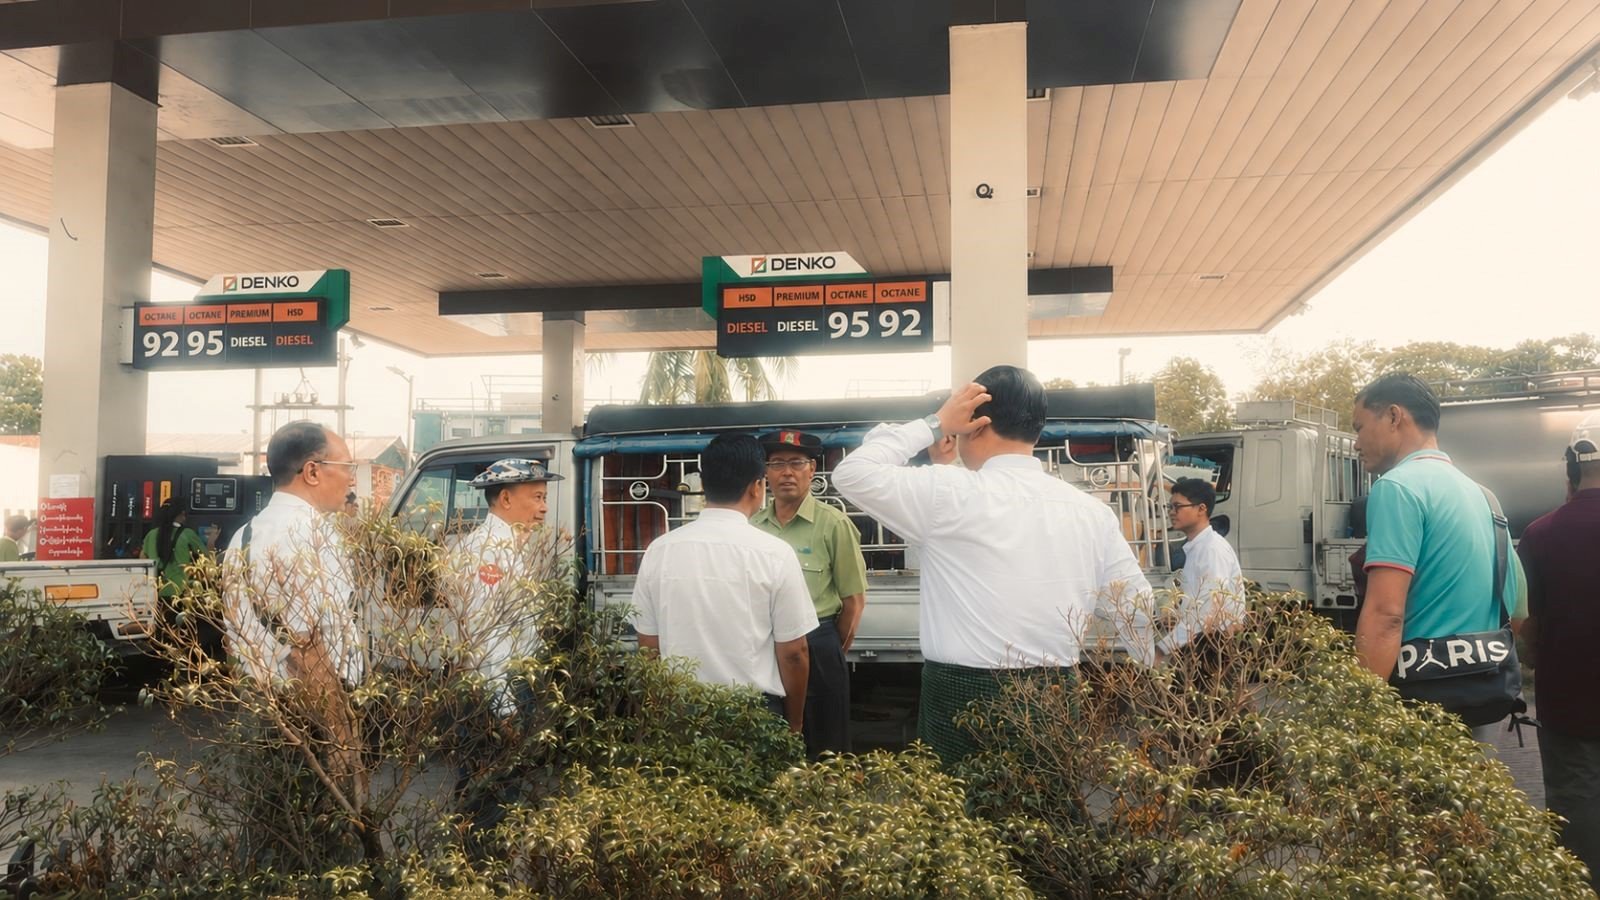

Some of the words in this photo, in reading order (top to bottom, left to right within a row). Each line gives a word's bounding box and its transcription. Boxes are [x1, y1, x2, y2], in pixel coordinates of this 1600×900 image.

[771, 256, 836, 271] DENKO
[241, 275, 299, 290] DENKO
[738, 294, 756, 303] HSD
[776, 291, 820, 301] PREMIUM
[830, 290, 868, 300] OCTANE
[881, 288, 920, 298] OCTANE
[144, 312, 177, 321] OCTANE
[189, 310, 222, 320] OCTANE
[230, 308, 270, 318] PREMIUM
[287, 308, 304, 317] HSD
[727, 322, 768, 334] DIESEL
[777, 320, 819, 332] DIESEL
[828, 311, 870, 339] 95
[878, 309, 922, 337] 92
[143, 331, 180, 358] 92
[187, 330, 224, 356] 95
[230, 336, 267, 347] DIESEL
[276, 335, 313, 346] DIESEL
